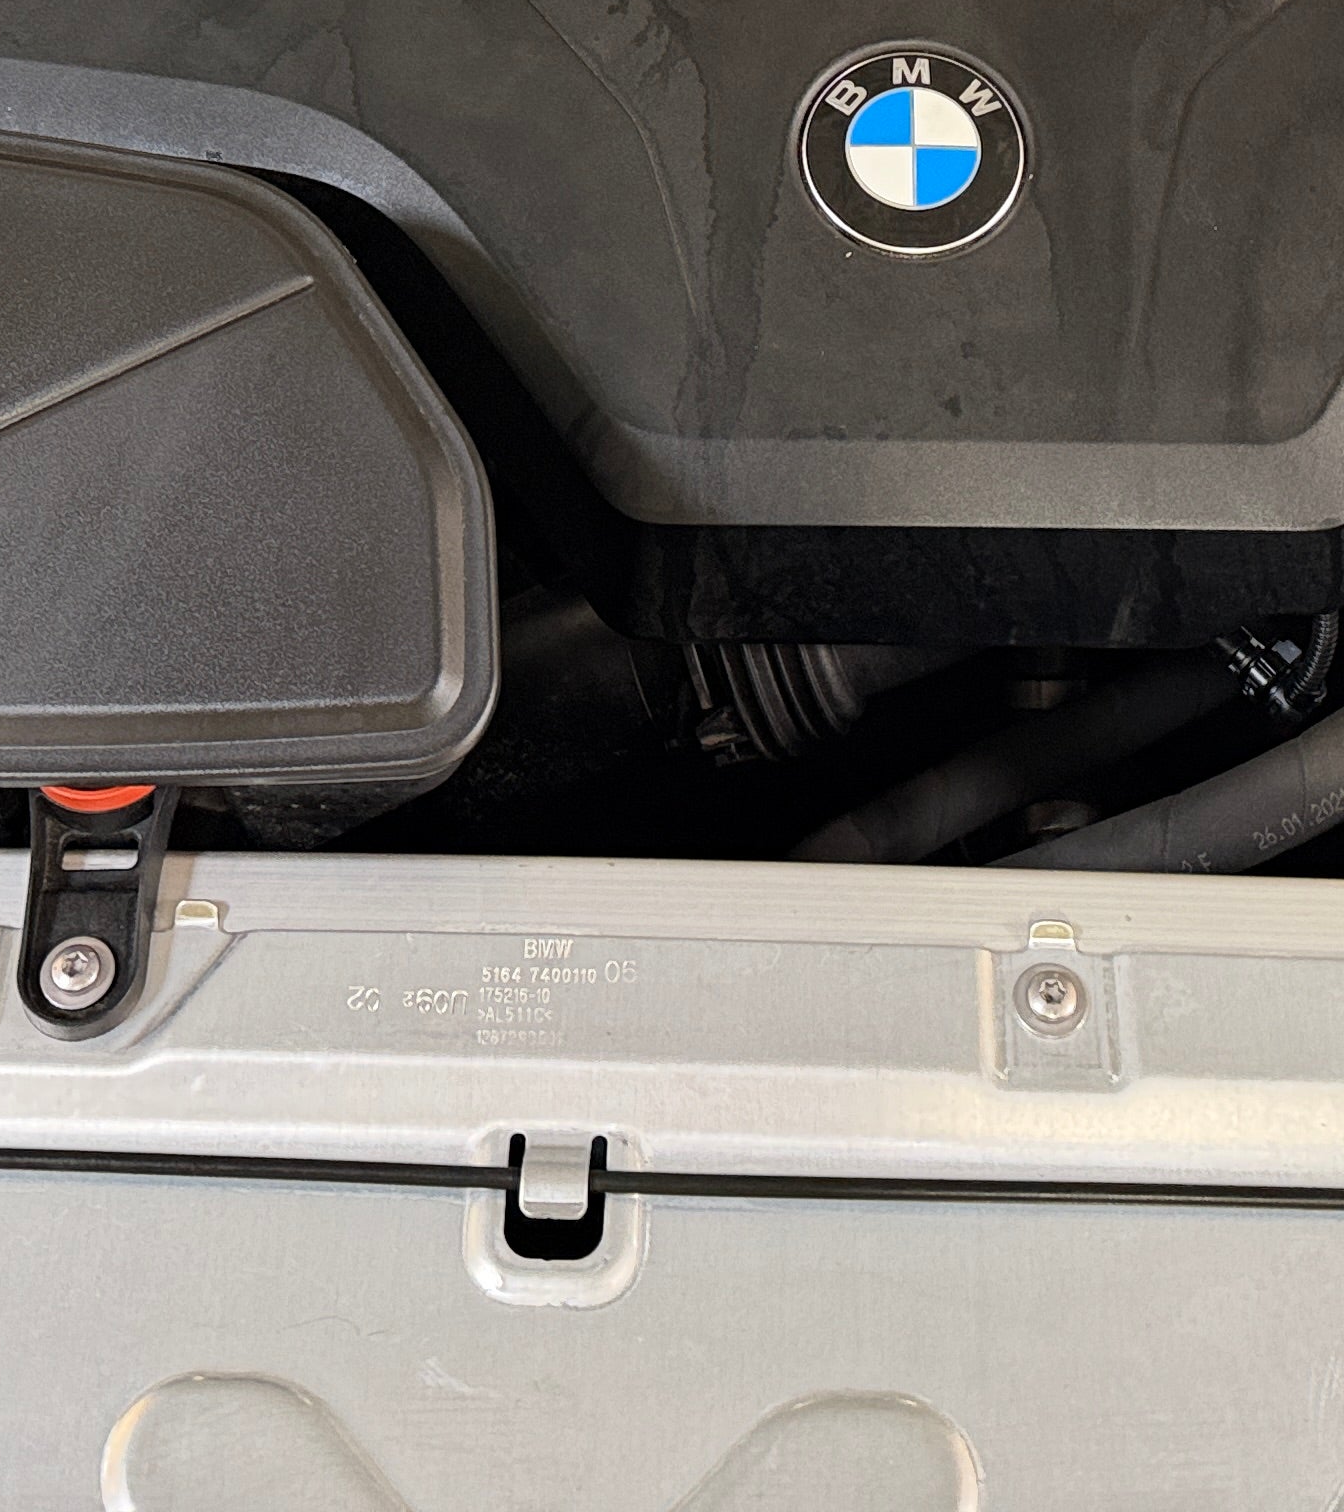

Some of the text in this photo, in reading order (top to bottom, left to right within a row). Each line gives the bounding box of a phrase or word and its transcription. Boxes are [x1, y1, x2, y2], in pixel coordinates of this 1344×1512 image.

[825, 57, 1003, 117] BMW
[524, 938, 574, 960] BMW
[482, 966, 521, 984] 5164
[530, 967, 597, 985] 7400110
[479, 986, 551, 1005] 175216-10
